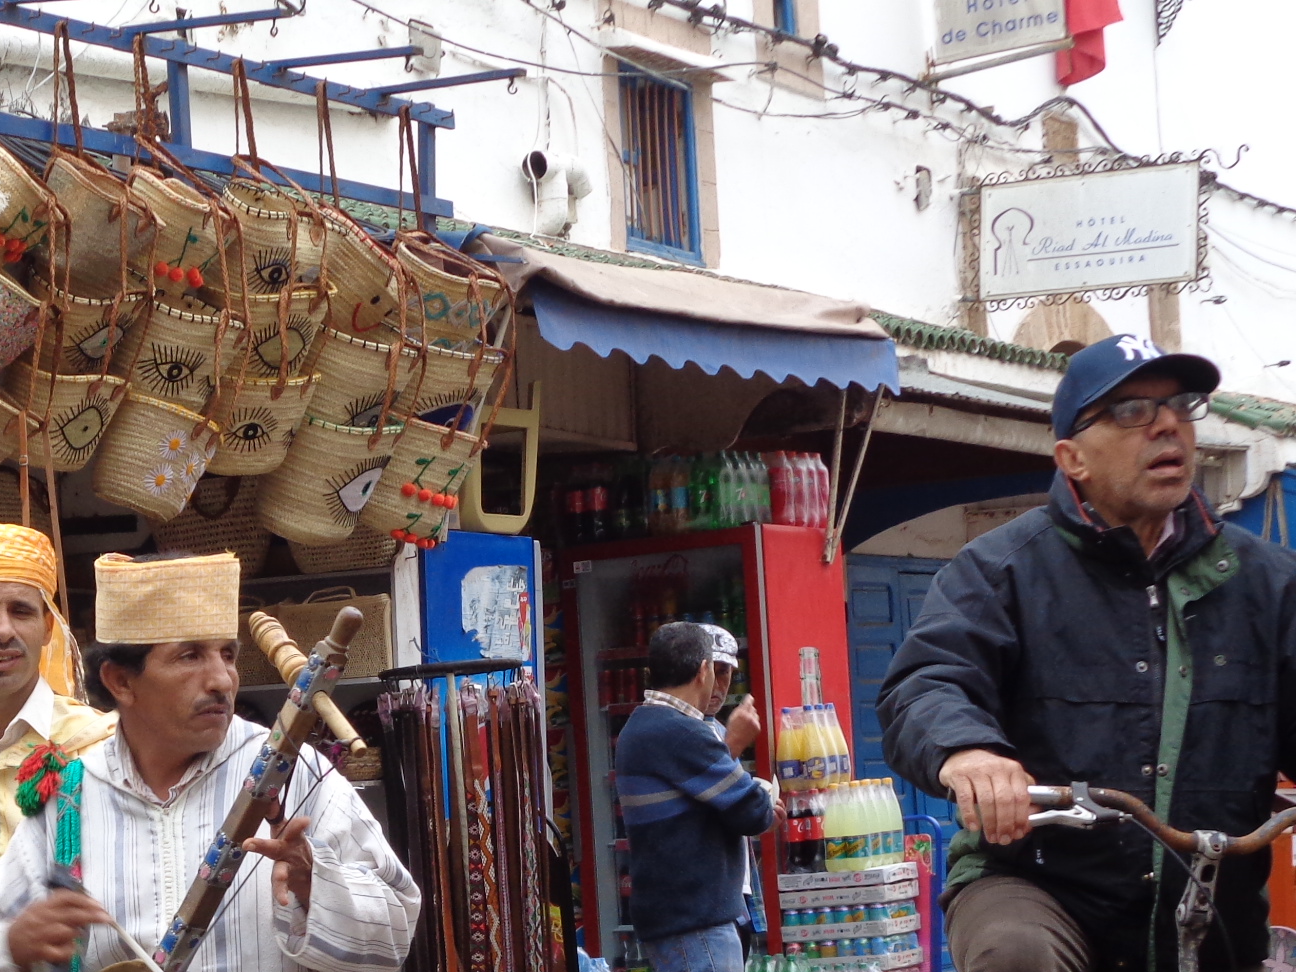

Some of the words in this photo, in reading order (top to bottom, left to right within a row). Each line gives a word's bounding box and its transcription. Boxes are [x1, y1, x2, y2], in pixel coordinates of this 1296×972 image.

[941, 28, 966, 44] de
[976, 10, 1059, 38] Charme
[1032, 236, 1076, 256] Riad
[1081, 230, 1109, 251] Al
[1114, 227, 1174, 247] Madina
[1054, 254, 1147, 271] ESSAOUIRA
